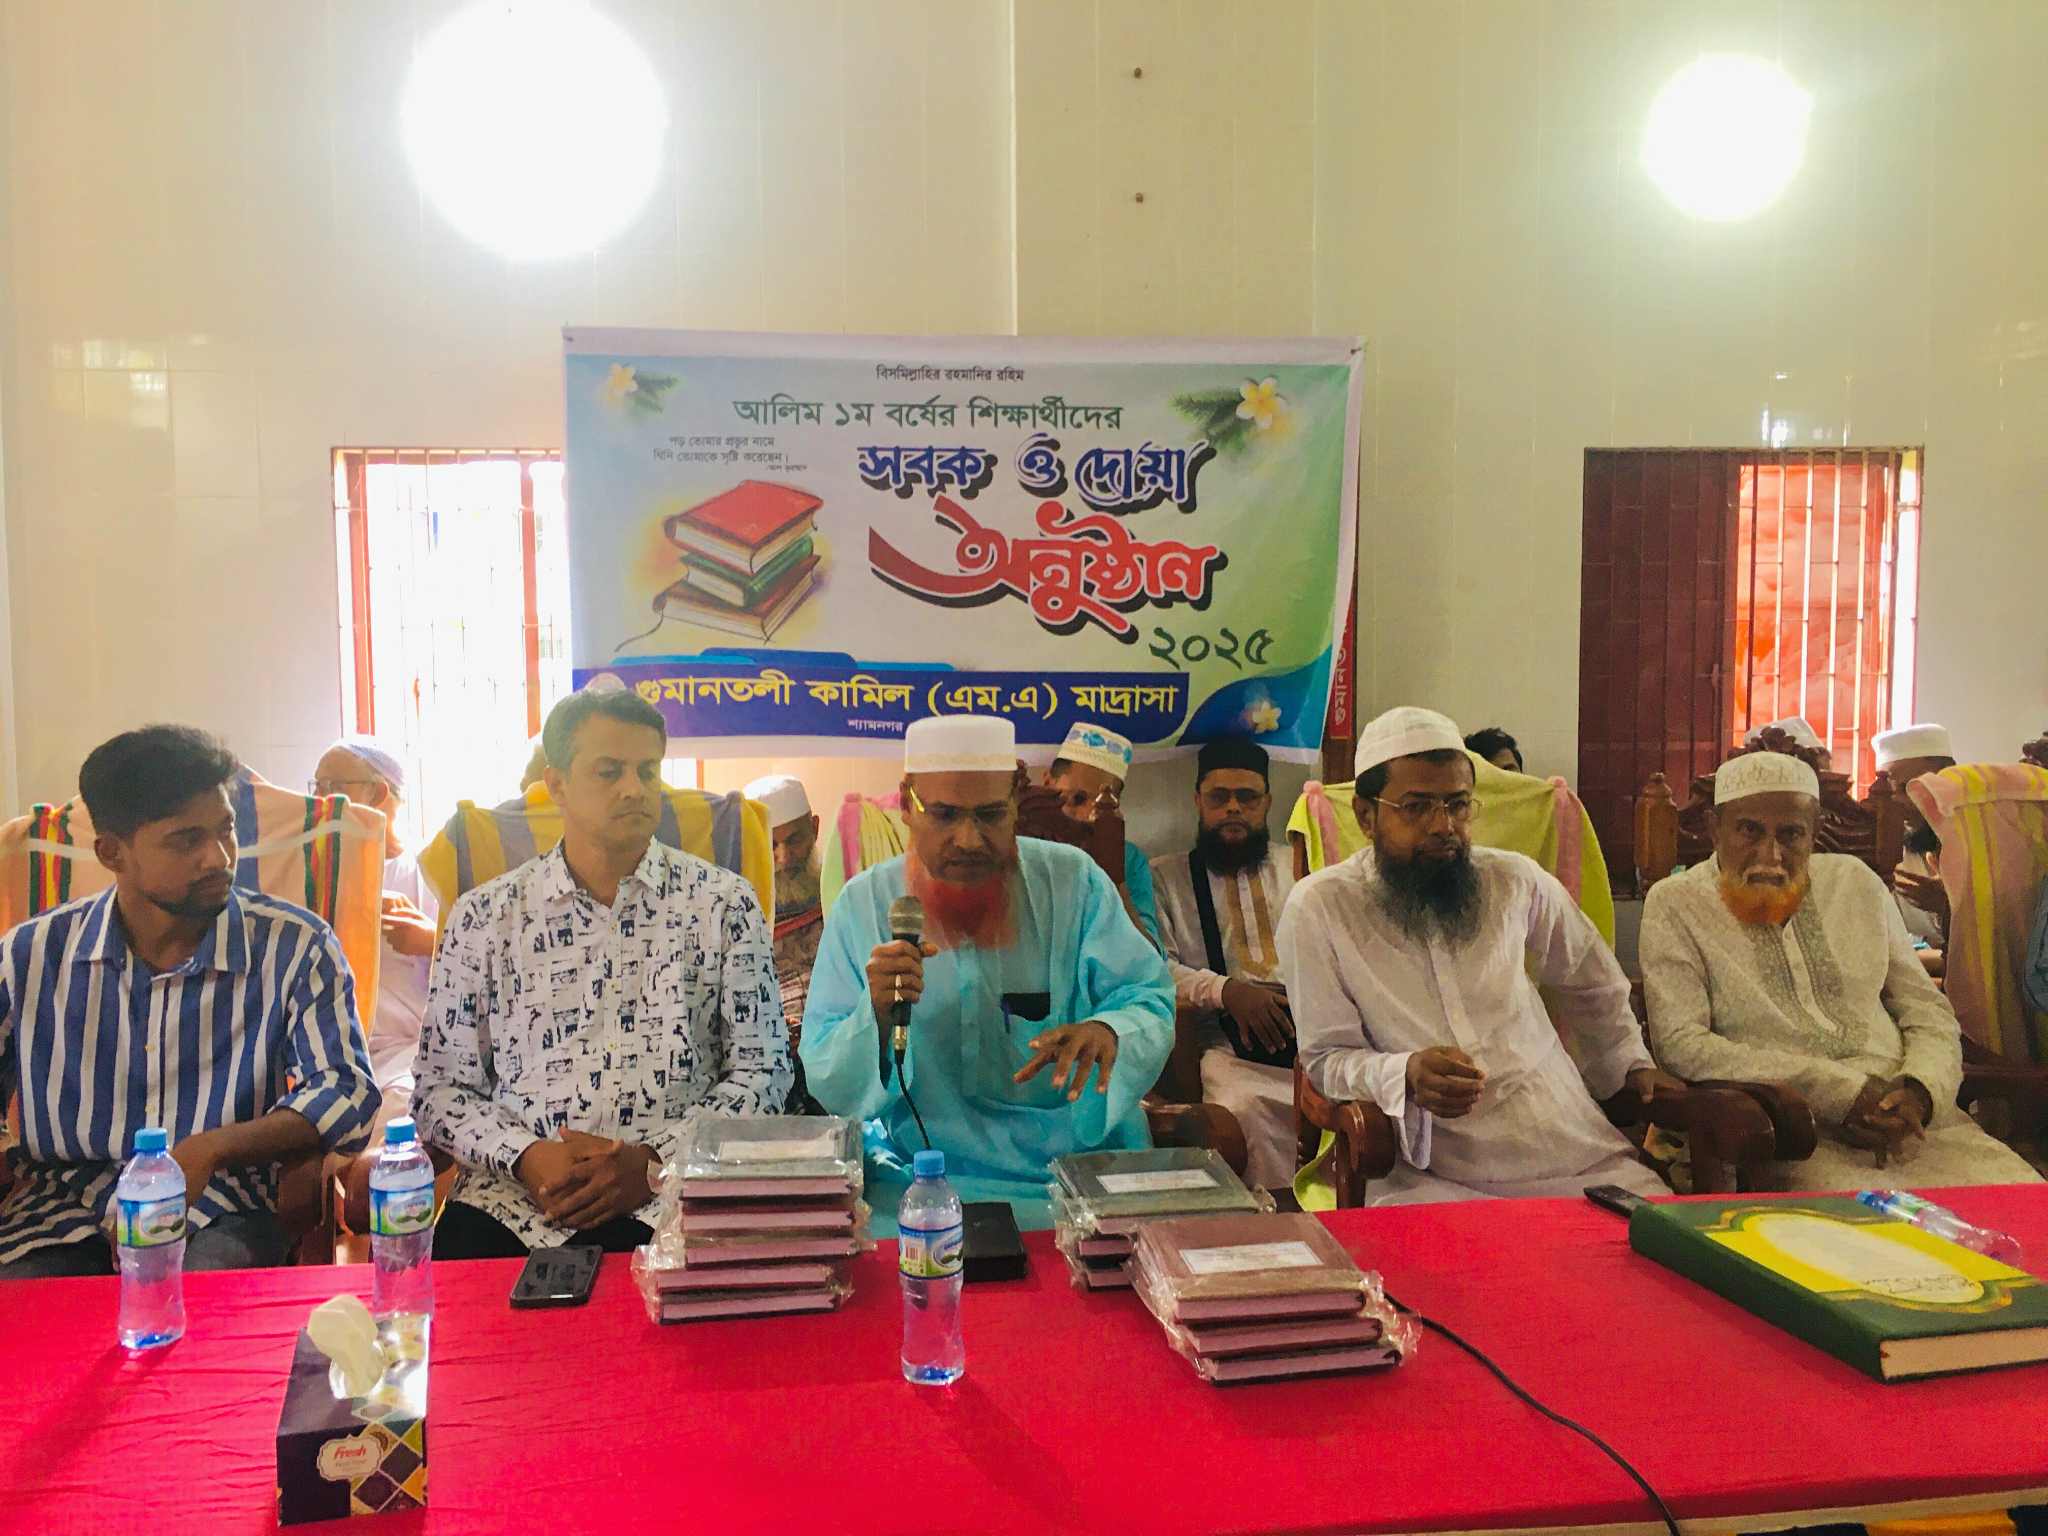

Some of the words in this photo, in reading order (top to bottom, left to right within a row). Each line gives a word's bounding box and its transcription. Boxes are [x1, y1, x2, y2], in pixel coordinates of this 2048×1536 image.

[944, 365, 992, 382] রহমানির
[996, 366, 1025, 383] রহিম
[732, 393, 824, 426] আলিম
[835, 402, 874, 427] ১ম
[884, 394, 958, 428] বর্ষের
[967, 396, 1123, 430] শিক্ষার্থীদের
[857, 445, 990, 491] সবক
[1015, 432, 1060, 489] ও
[1073, 441, 1209, 508] দোয়া
[868, 494, 1221, 636] অনুষ্ঠান
[1148, 626, 1275, 671] ২০২৫
[635, 668, 797, 706] গুমানতলী
[804, 674, 915, 711] কামিল
[927, 681, 1059, 721] (এম.এ)
[1070, 684, 1179, 717] মাদ্রাসা
[334, 1445, 367, 1459] Fresh
